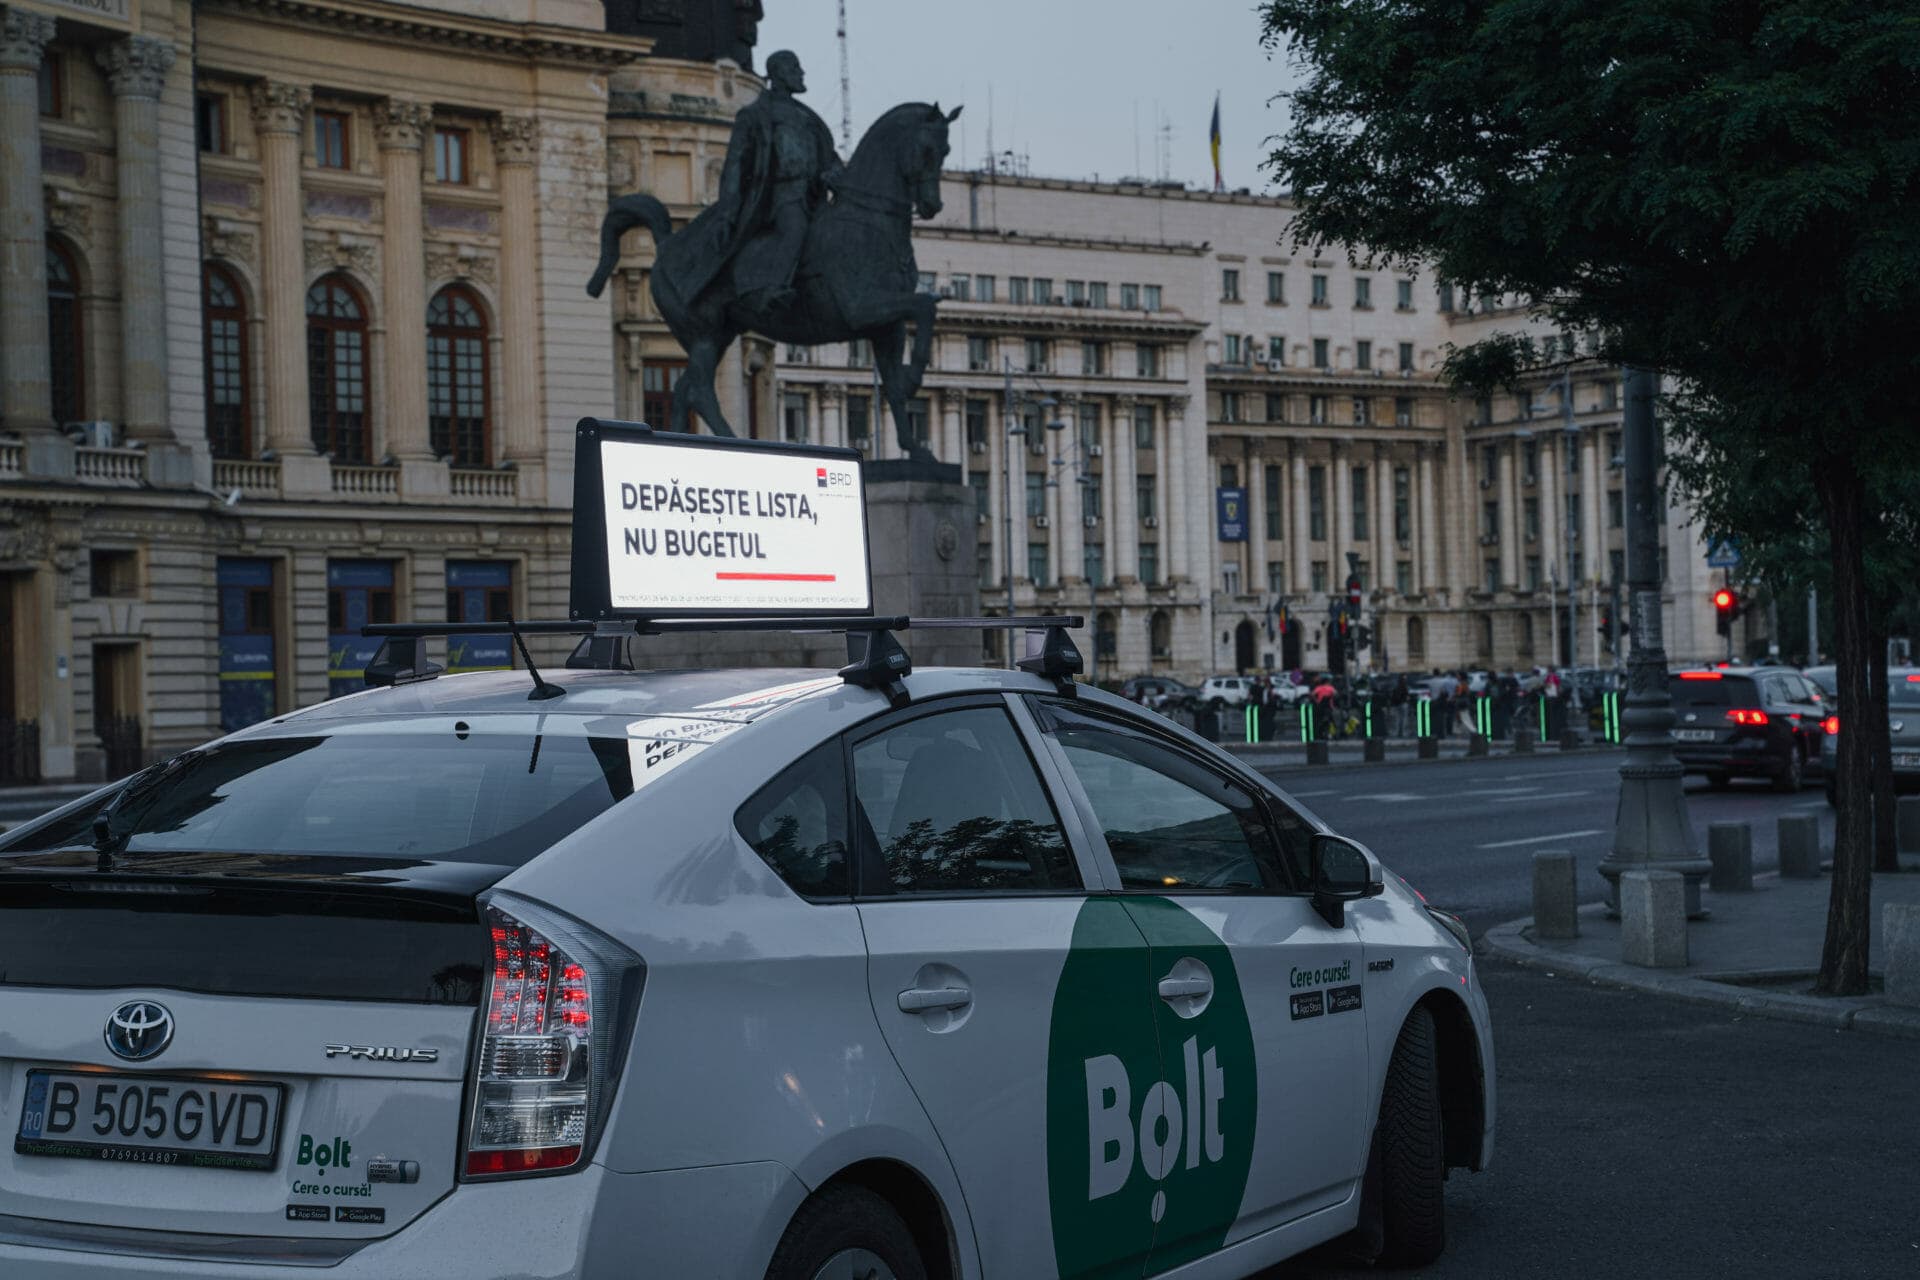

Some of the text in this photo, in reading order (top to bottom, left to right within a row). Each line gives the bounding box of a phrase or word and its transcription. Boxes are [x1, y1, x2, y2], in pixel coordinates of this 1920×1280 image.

[829, 472, 852, 486] BRD
[621, 478, 818, 525] DEPĂȘEȘTE LISTA,
[624, 527, 766, 559] NU BUGETUL
[233, 653, 268, 664] EUROPA
[1290, 966, 1312, 988] Cere
[1314, 969, 1321, 985] o
[1322, 960, 1351, 982] cursă!
[325, 1044, 438, 1063] PRIUS
[47, 1082, 79, 1133] B
[24, 1111, 42, 1131] RO
[1084, 1034, 1225, 1223] Bolt
[102, 1148, 179, 1164] 0769614807
[297, 1134, 352, 1176] Bolt
[293, 1180, 372, 1197] Cere o cursă!
[298, 1211, 311, 1219] App
[349, 1213, 382, 1221] Google Play
